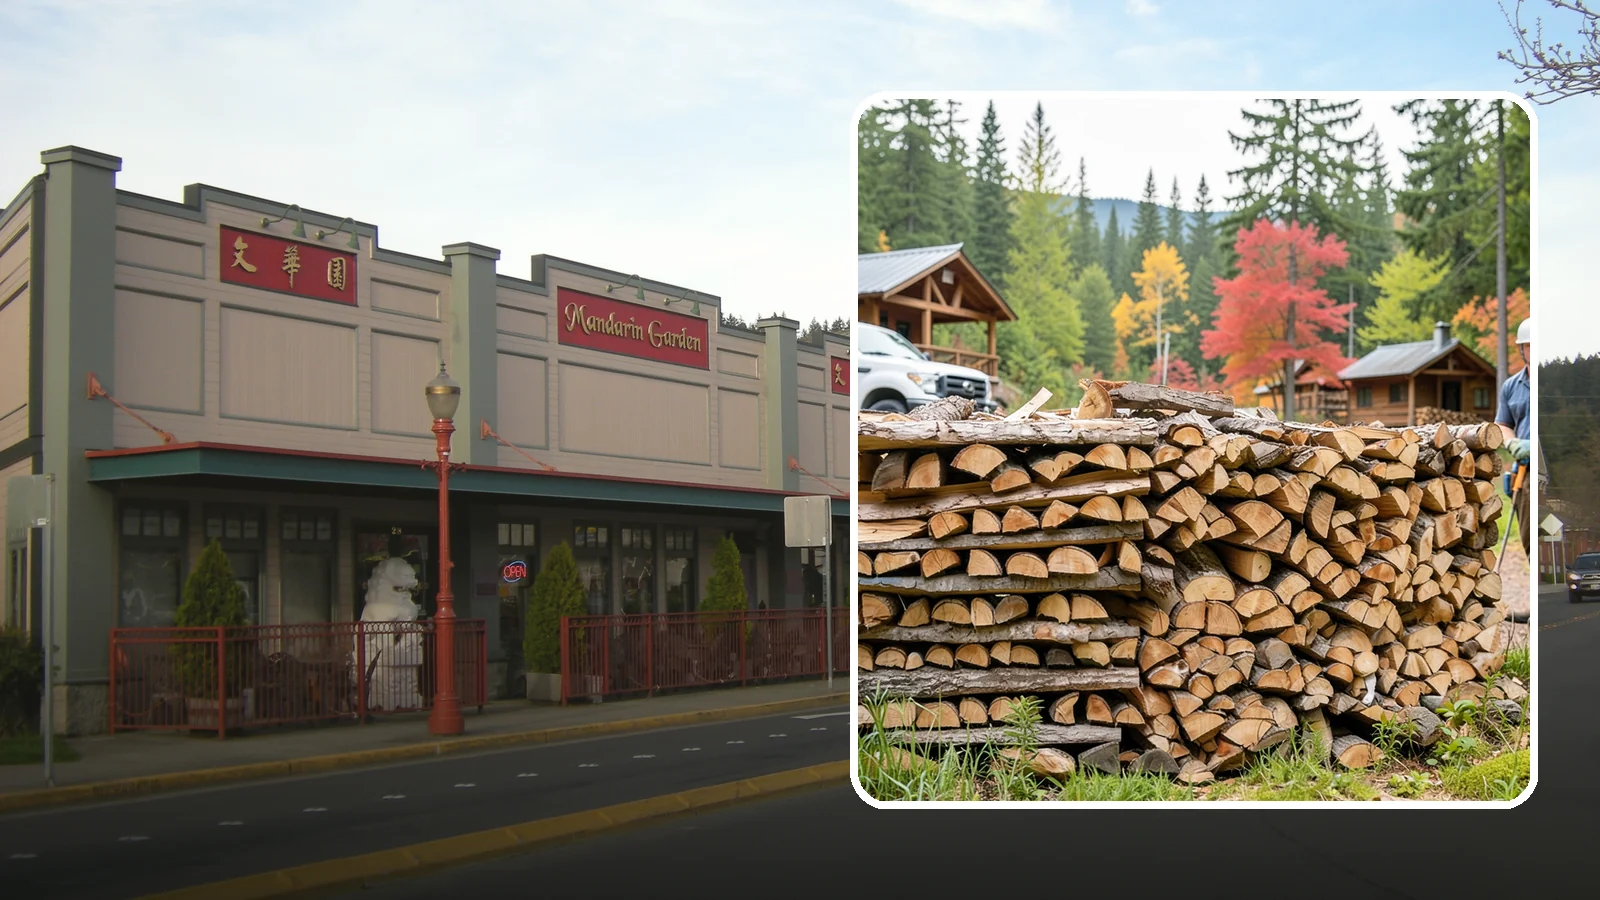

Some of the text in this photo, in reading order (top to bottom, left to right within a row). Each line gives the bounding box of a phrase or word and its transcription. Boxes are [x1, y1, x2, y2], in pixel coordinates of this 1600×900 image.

[230, 235, 346, 291] 文華園
[564, 302, 702, 352] Mandarin Garden
[834, 363, 847, 386] 文
[503, 565, 527, 578] OPEN
